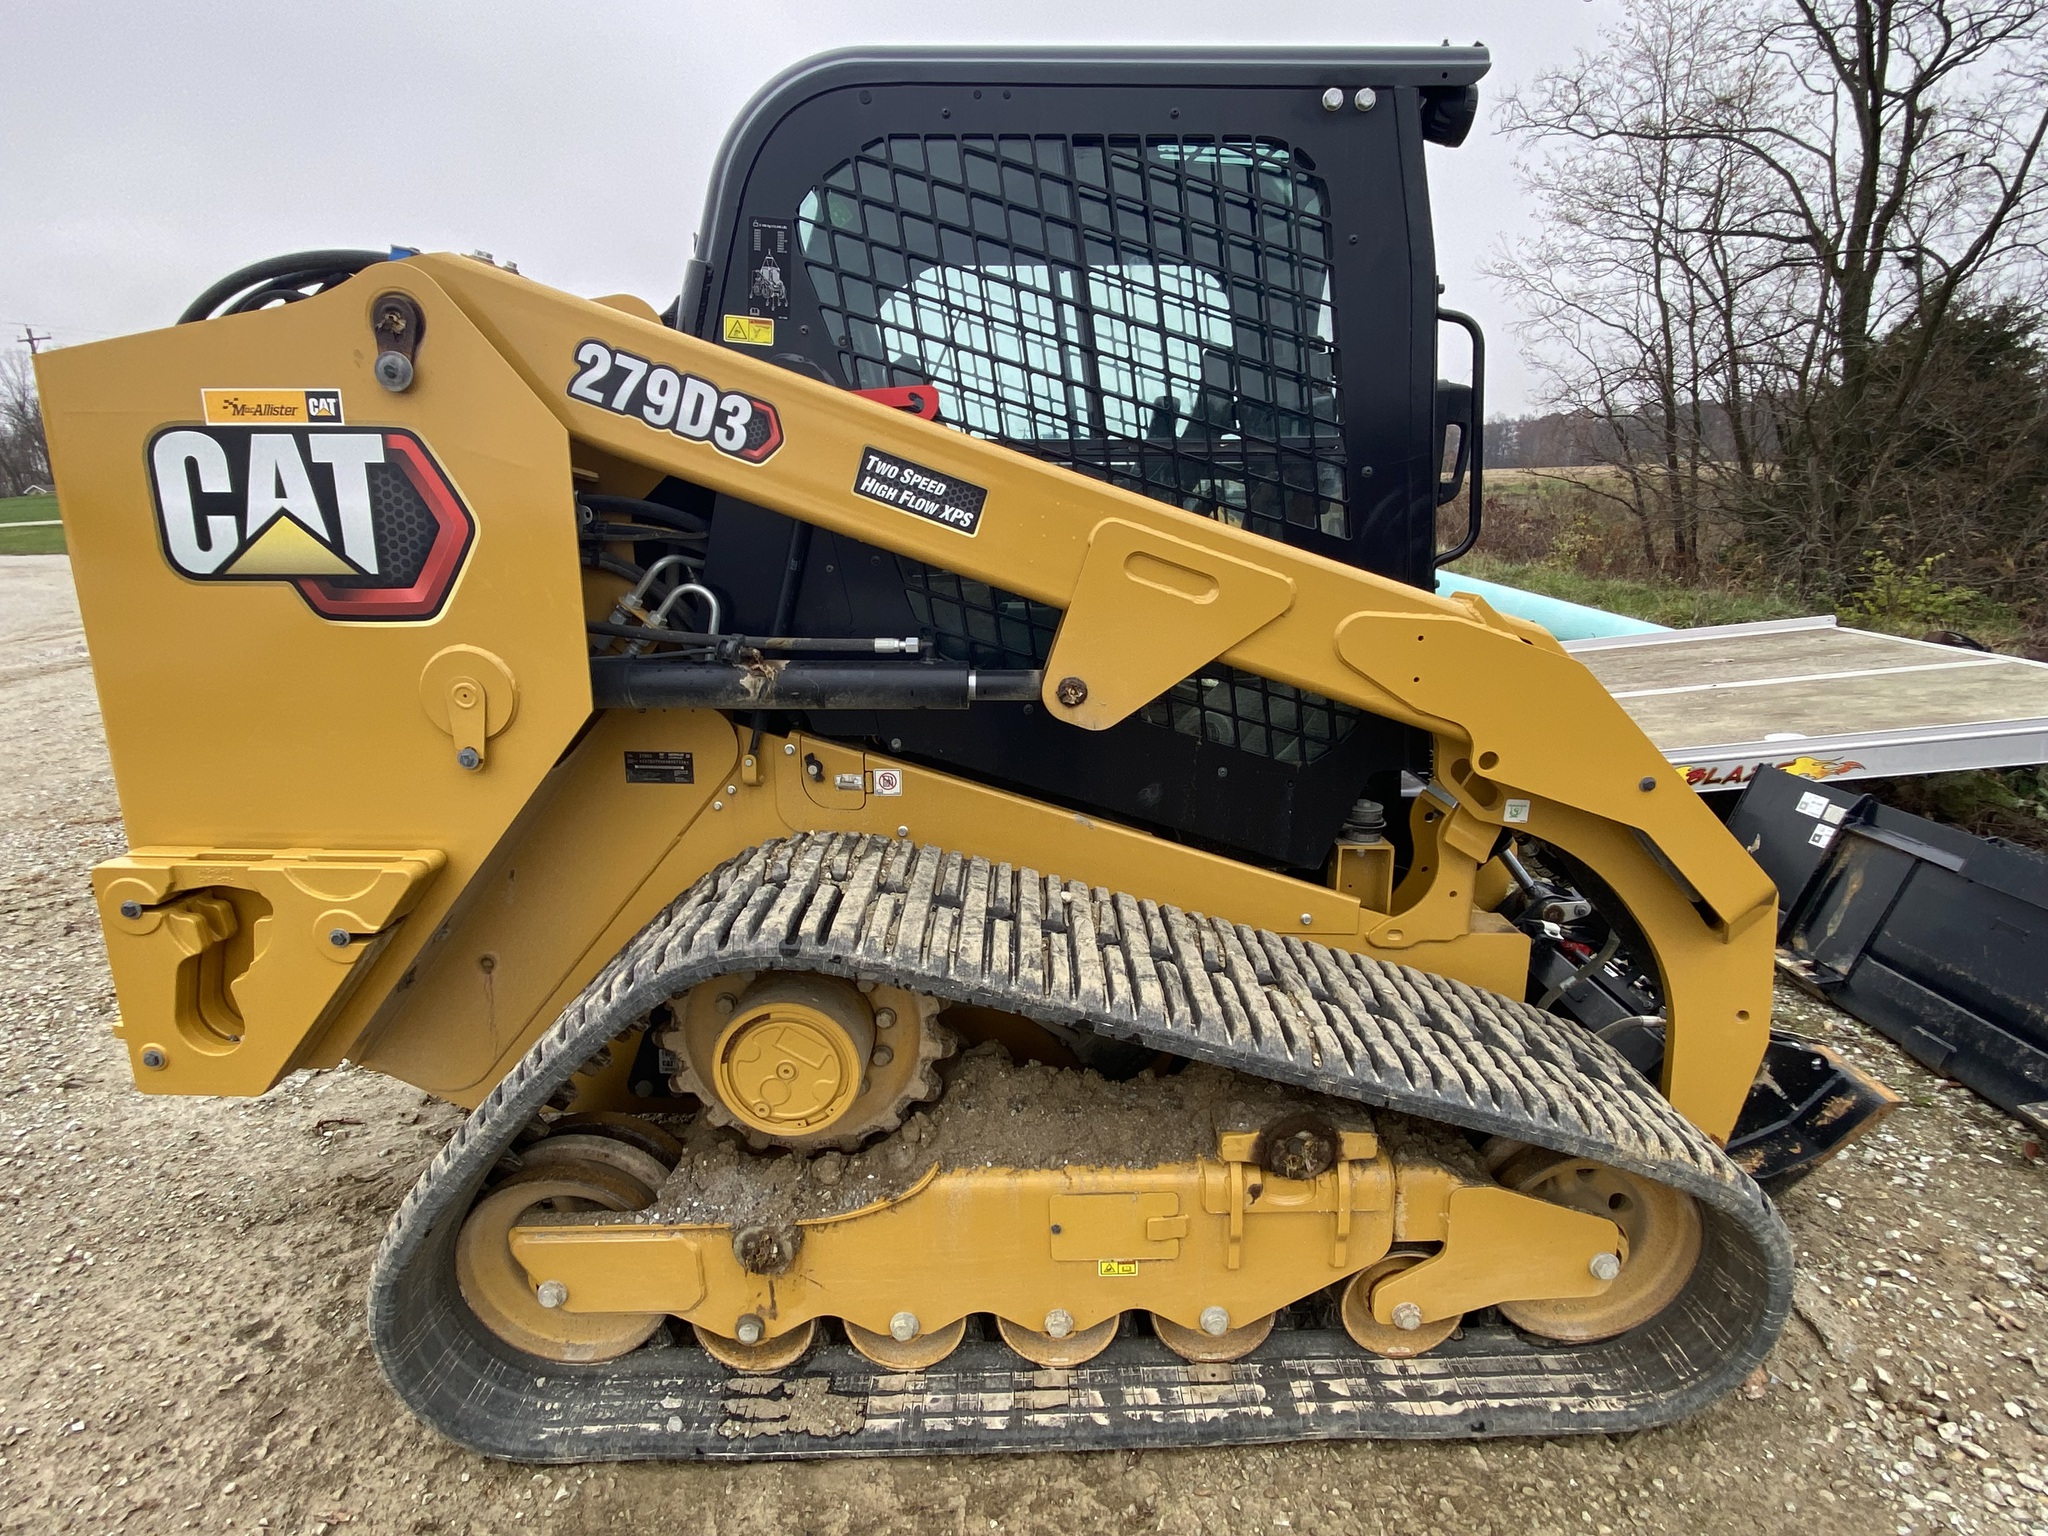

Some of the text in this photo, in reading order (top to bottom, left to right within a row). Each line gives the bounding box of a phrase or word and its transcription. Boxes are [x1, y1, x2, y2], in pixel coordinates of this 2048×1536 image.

[232, 398, 337, 416] MacAllister CAT
[571, 343, 752, 451] 279D3
[866, 455, 947, 496] TWO SPEED
[153, 430, 385, 575] CAT
[860, 476, 974, 527] HIGH FLOW XPS
